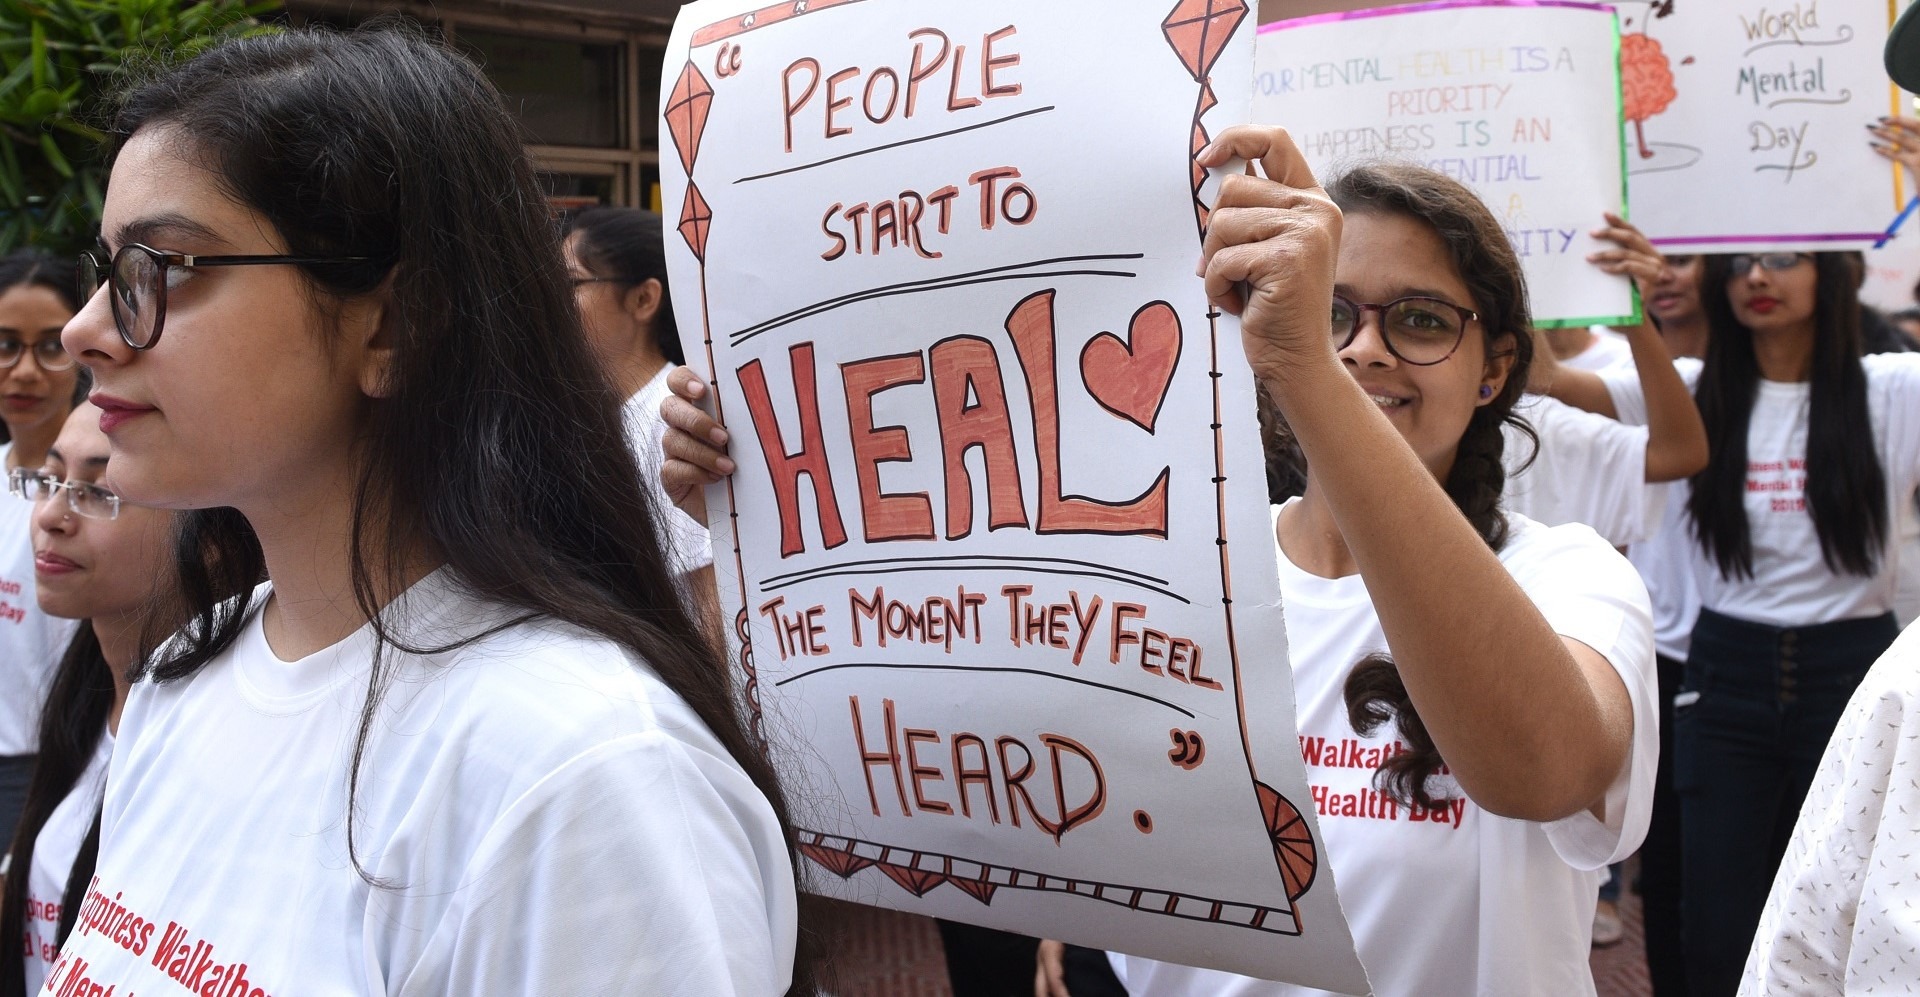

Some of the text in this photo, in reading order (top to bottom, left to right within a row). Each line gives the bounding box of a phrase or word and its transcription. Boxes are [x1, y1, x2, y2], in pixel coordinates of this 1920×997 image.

[782, 24, 1022, 153] PEOPLE
[1300, 57, 1392, 89] MENTAL
[1509, 46, 1550, 73] IS
[1553, 47, 1576, 73] A
[1736, 56, 1826, 104] Mental
[1387, 83, 1513, 118] PRIORITY
[1304, 117, 1552, 157] HAPPINESS IS AN
[1749, 120, 1809, 184] Day
[821, 165, 1039, 262] START TO
[735, 288, 1170, 559] HEAL
[758, 584, 1225, 692] THE MOMENT THEY FEEL
[1311, 785, 1397, 821] Health
